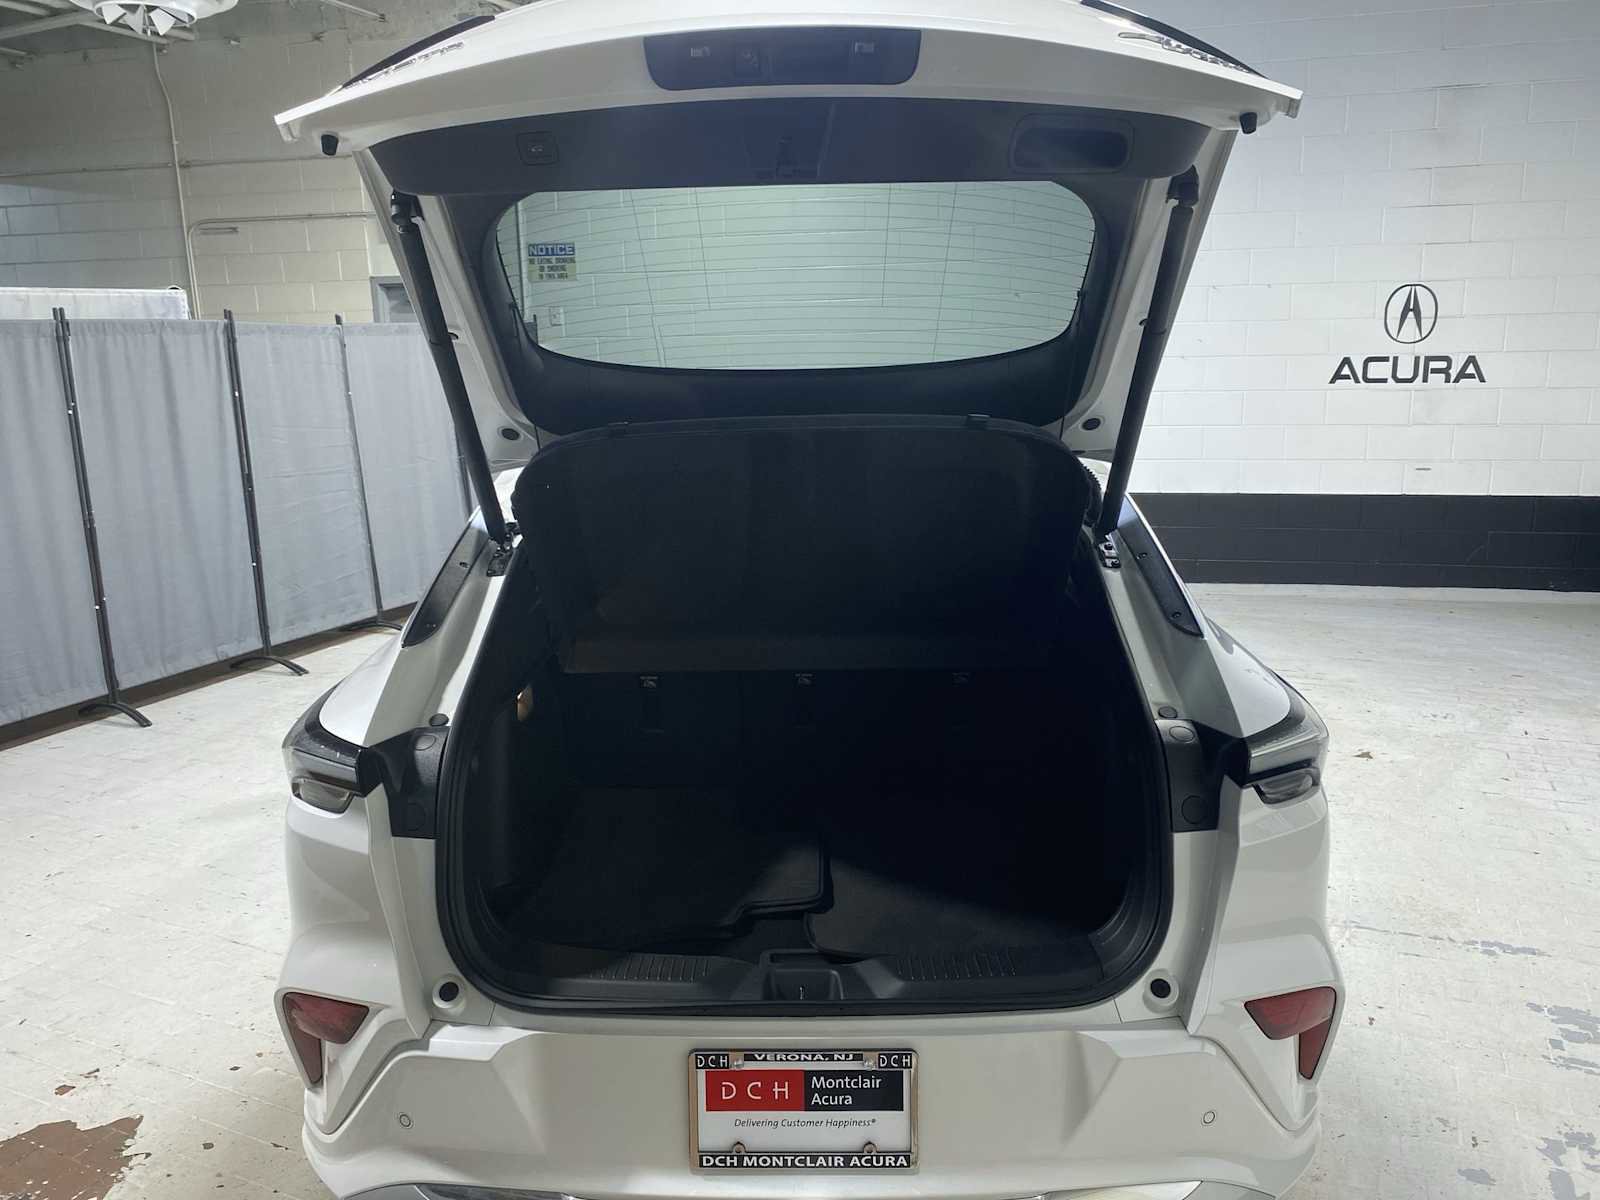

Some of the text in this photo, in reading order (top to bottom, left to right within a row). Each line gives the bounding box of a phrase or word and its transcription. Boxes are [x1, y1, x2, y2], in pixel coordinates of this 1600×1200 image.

[529, 244, 575, 255] NOTICE
[1328, 355, 1487, 384] ACURA
[754, 1053, 854, 1061] VERONA, NJ
[811, 1075, 881, 1089] Montclair
[811, 1092, 853, 1105] Acura
[734, 1118, 779, 1129] Delivering
[781, 1118, 823, 1127] Customer
[702, 1155, 908, 1167] DCH MONTCLAIR ACURA
